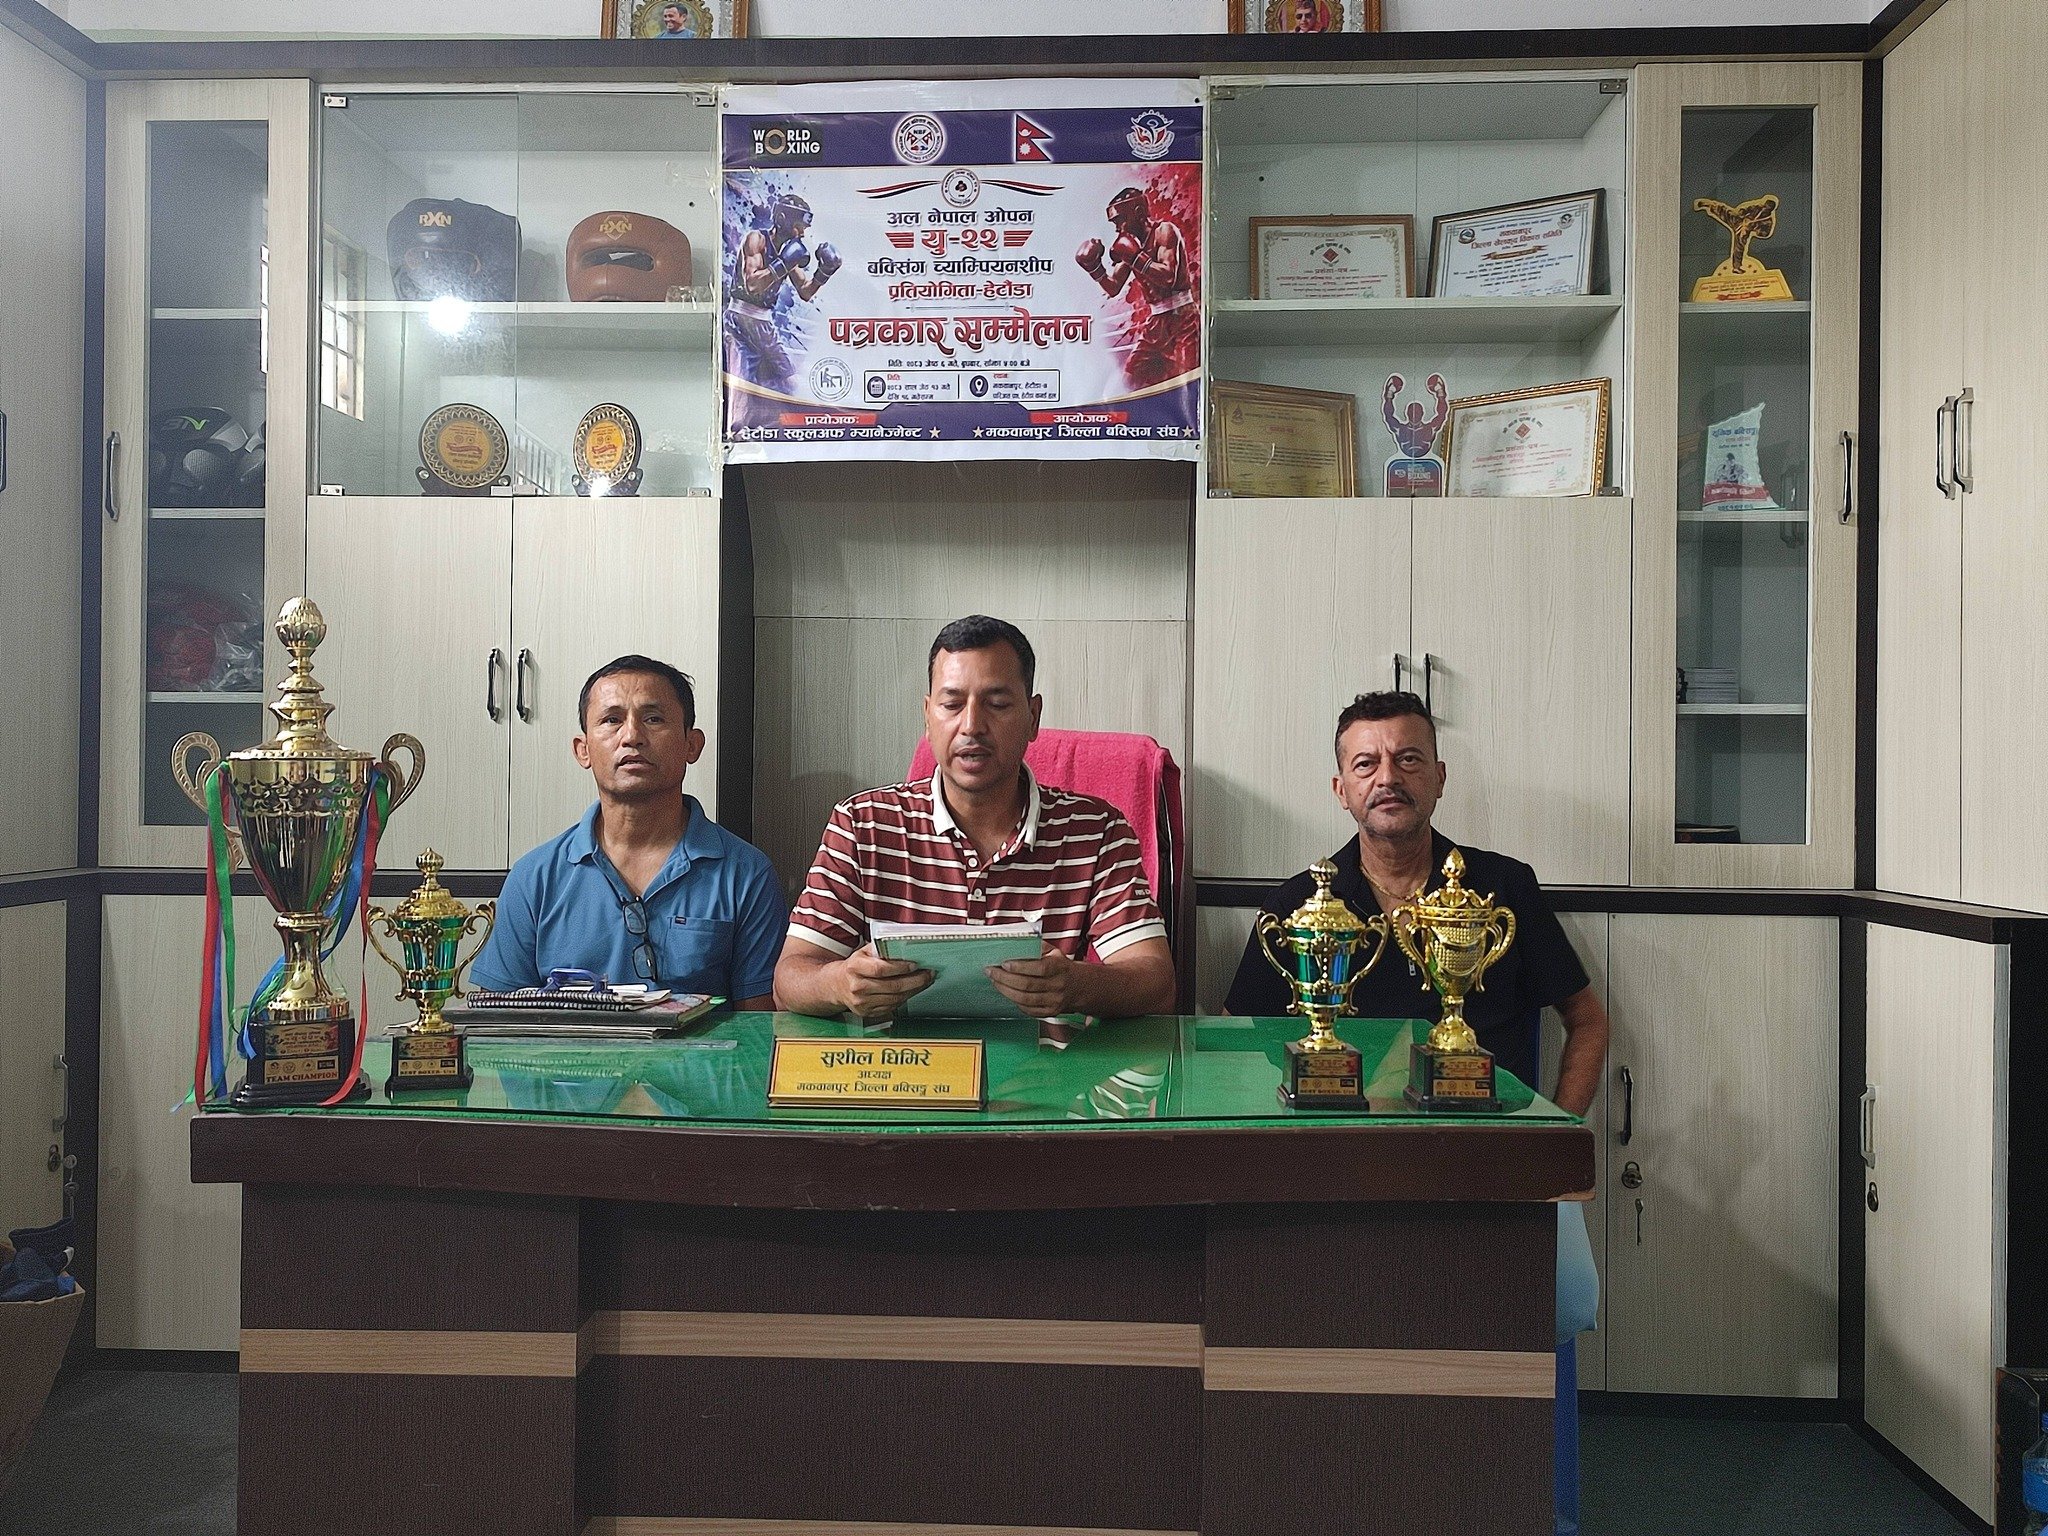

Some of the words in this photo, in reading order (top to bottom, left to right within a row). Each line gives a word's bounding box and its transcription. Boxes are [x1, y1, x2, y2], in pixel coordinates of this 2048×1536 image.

[753, 129, 811, 141] WORLD
[755, 141, 821, 154] BOXING
[419, 211, 452, 227] RXN
[887, 212, 921, 225] अल
[928, 208, 977, 224] नेपाल
[984, 207, 1034, 223] ओपन
[599, 220, 632, 234] RXN
[933, 256, 1053, 274] च्याम्पियनशीप
[828, 317, 954, 354] पत्रकार
[953, 306, 1092, 350] सम्मेलन
[985, 426, 1053, 439] मकवानपुर
[1057, 424, 1101, 438] जिल्ला
[1156, 425, 1180, 437] संघ
[820, 1048, 874, 1068] सुशील
[881, 1048, 932, 1067] घिमिरे
[266, 1074, 290, 1083] TEAM
[292, 1072, 338, 1081] CHAMPION
[857, 1070, 892, 1079] अध्यक्ष
[796, 1083, 849, 1093] मकवानपुर
[854, 1081, 888, 1093] जिल्ला
[933, 1083, 950, 1094] संघ
